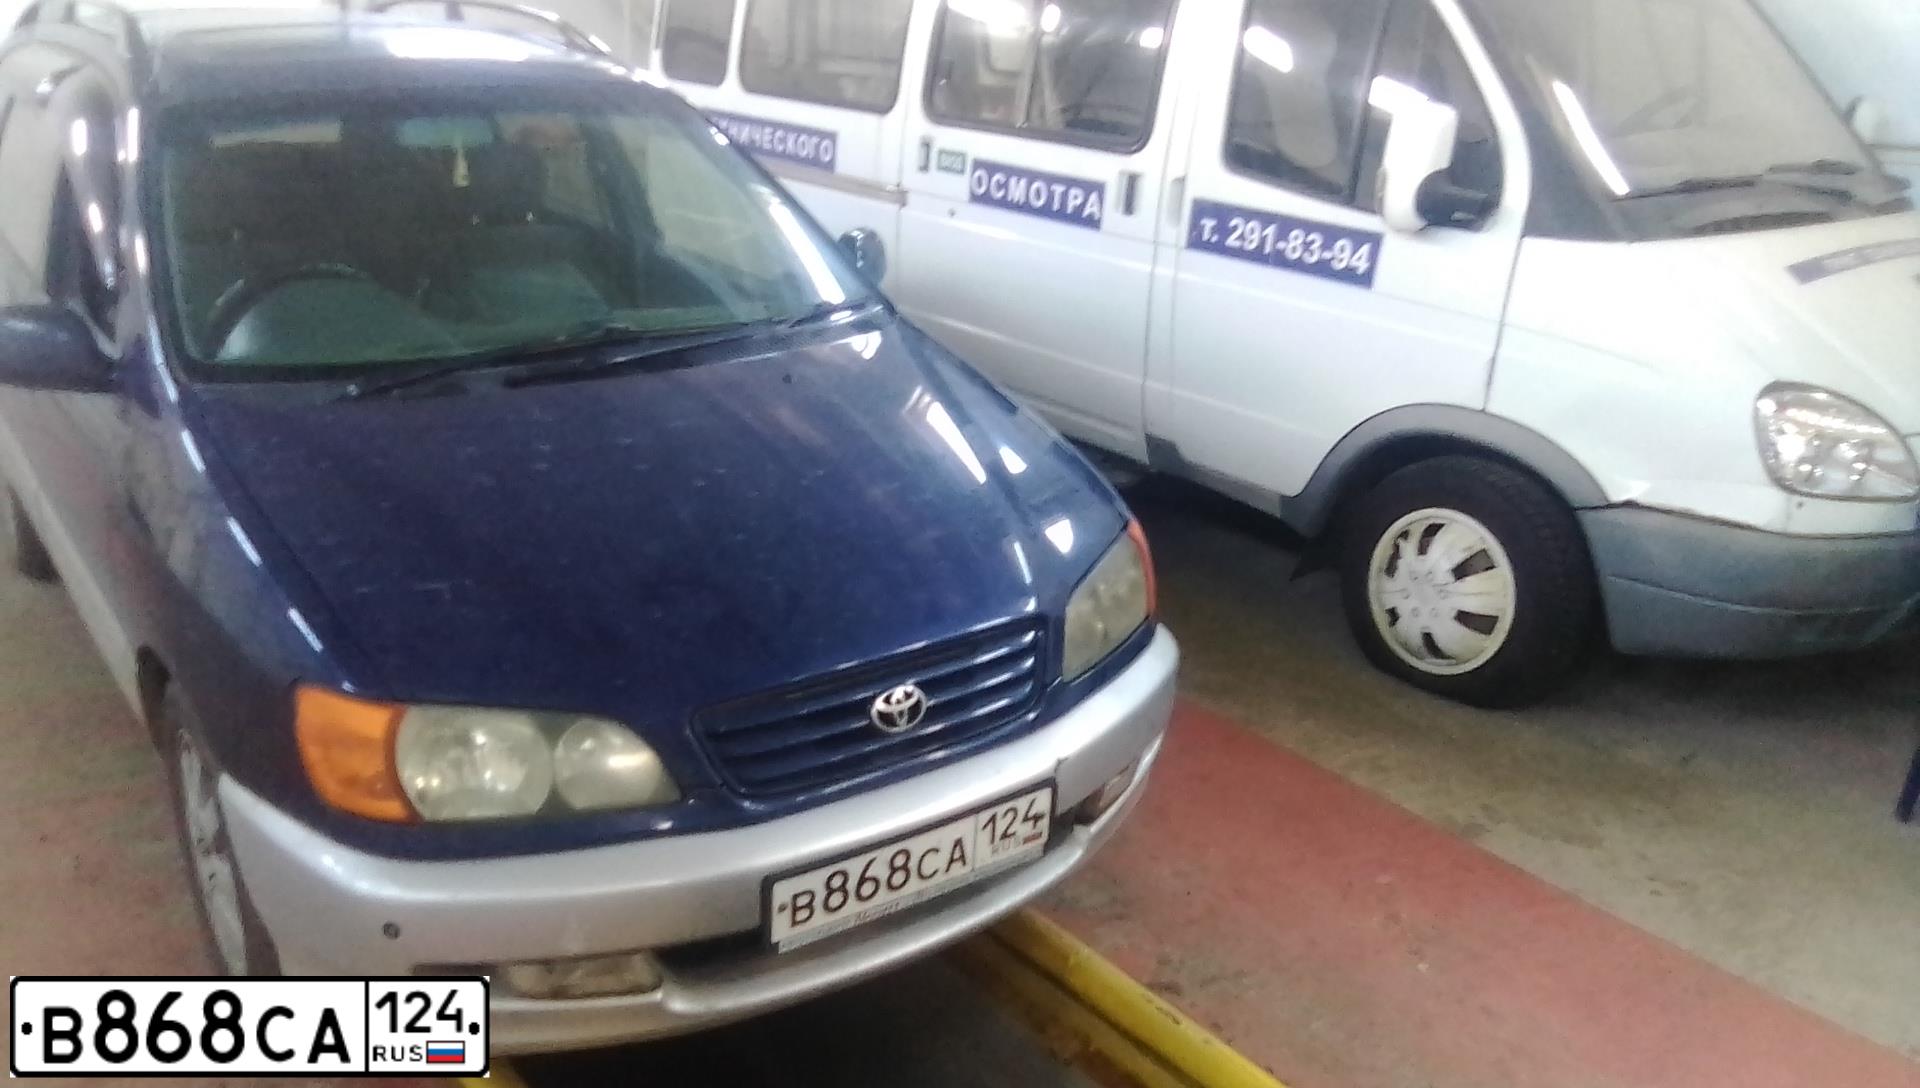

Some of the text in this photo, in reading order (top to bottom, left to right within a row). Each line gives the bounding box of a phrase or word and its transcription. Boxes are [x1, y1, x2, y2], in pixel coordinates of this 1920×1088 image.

[970, 169, 1101, 221] ОСМОТРА
[1226, 219, 1372, 276] 291-83-94
[790, 838, 967, 928] В868СА
[982, 798, 1044, 845] 124
